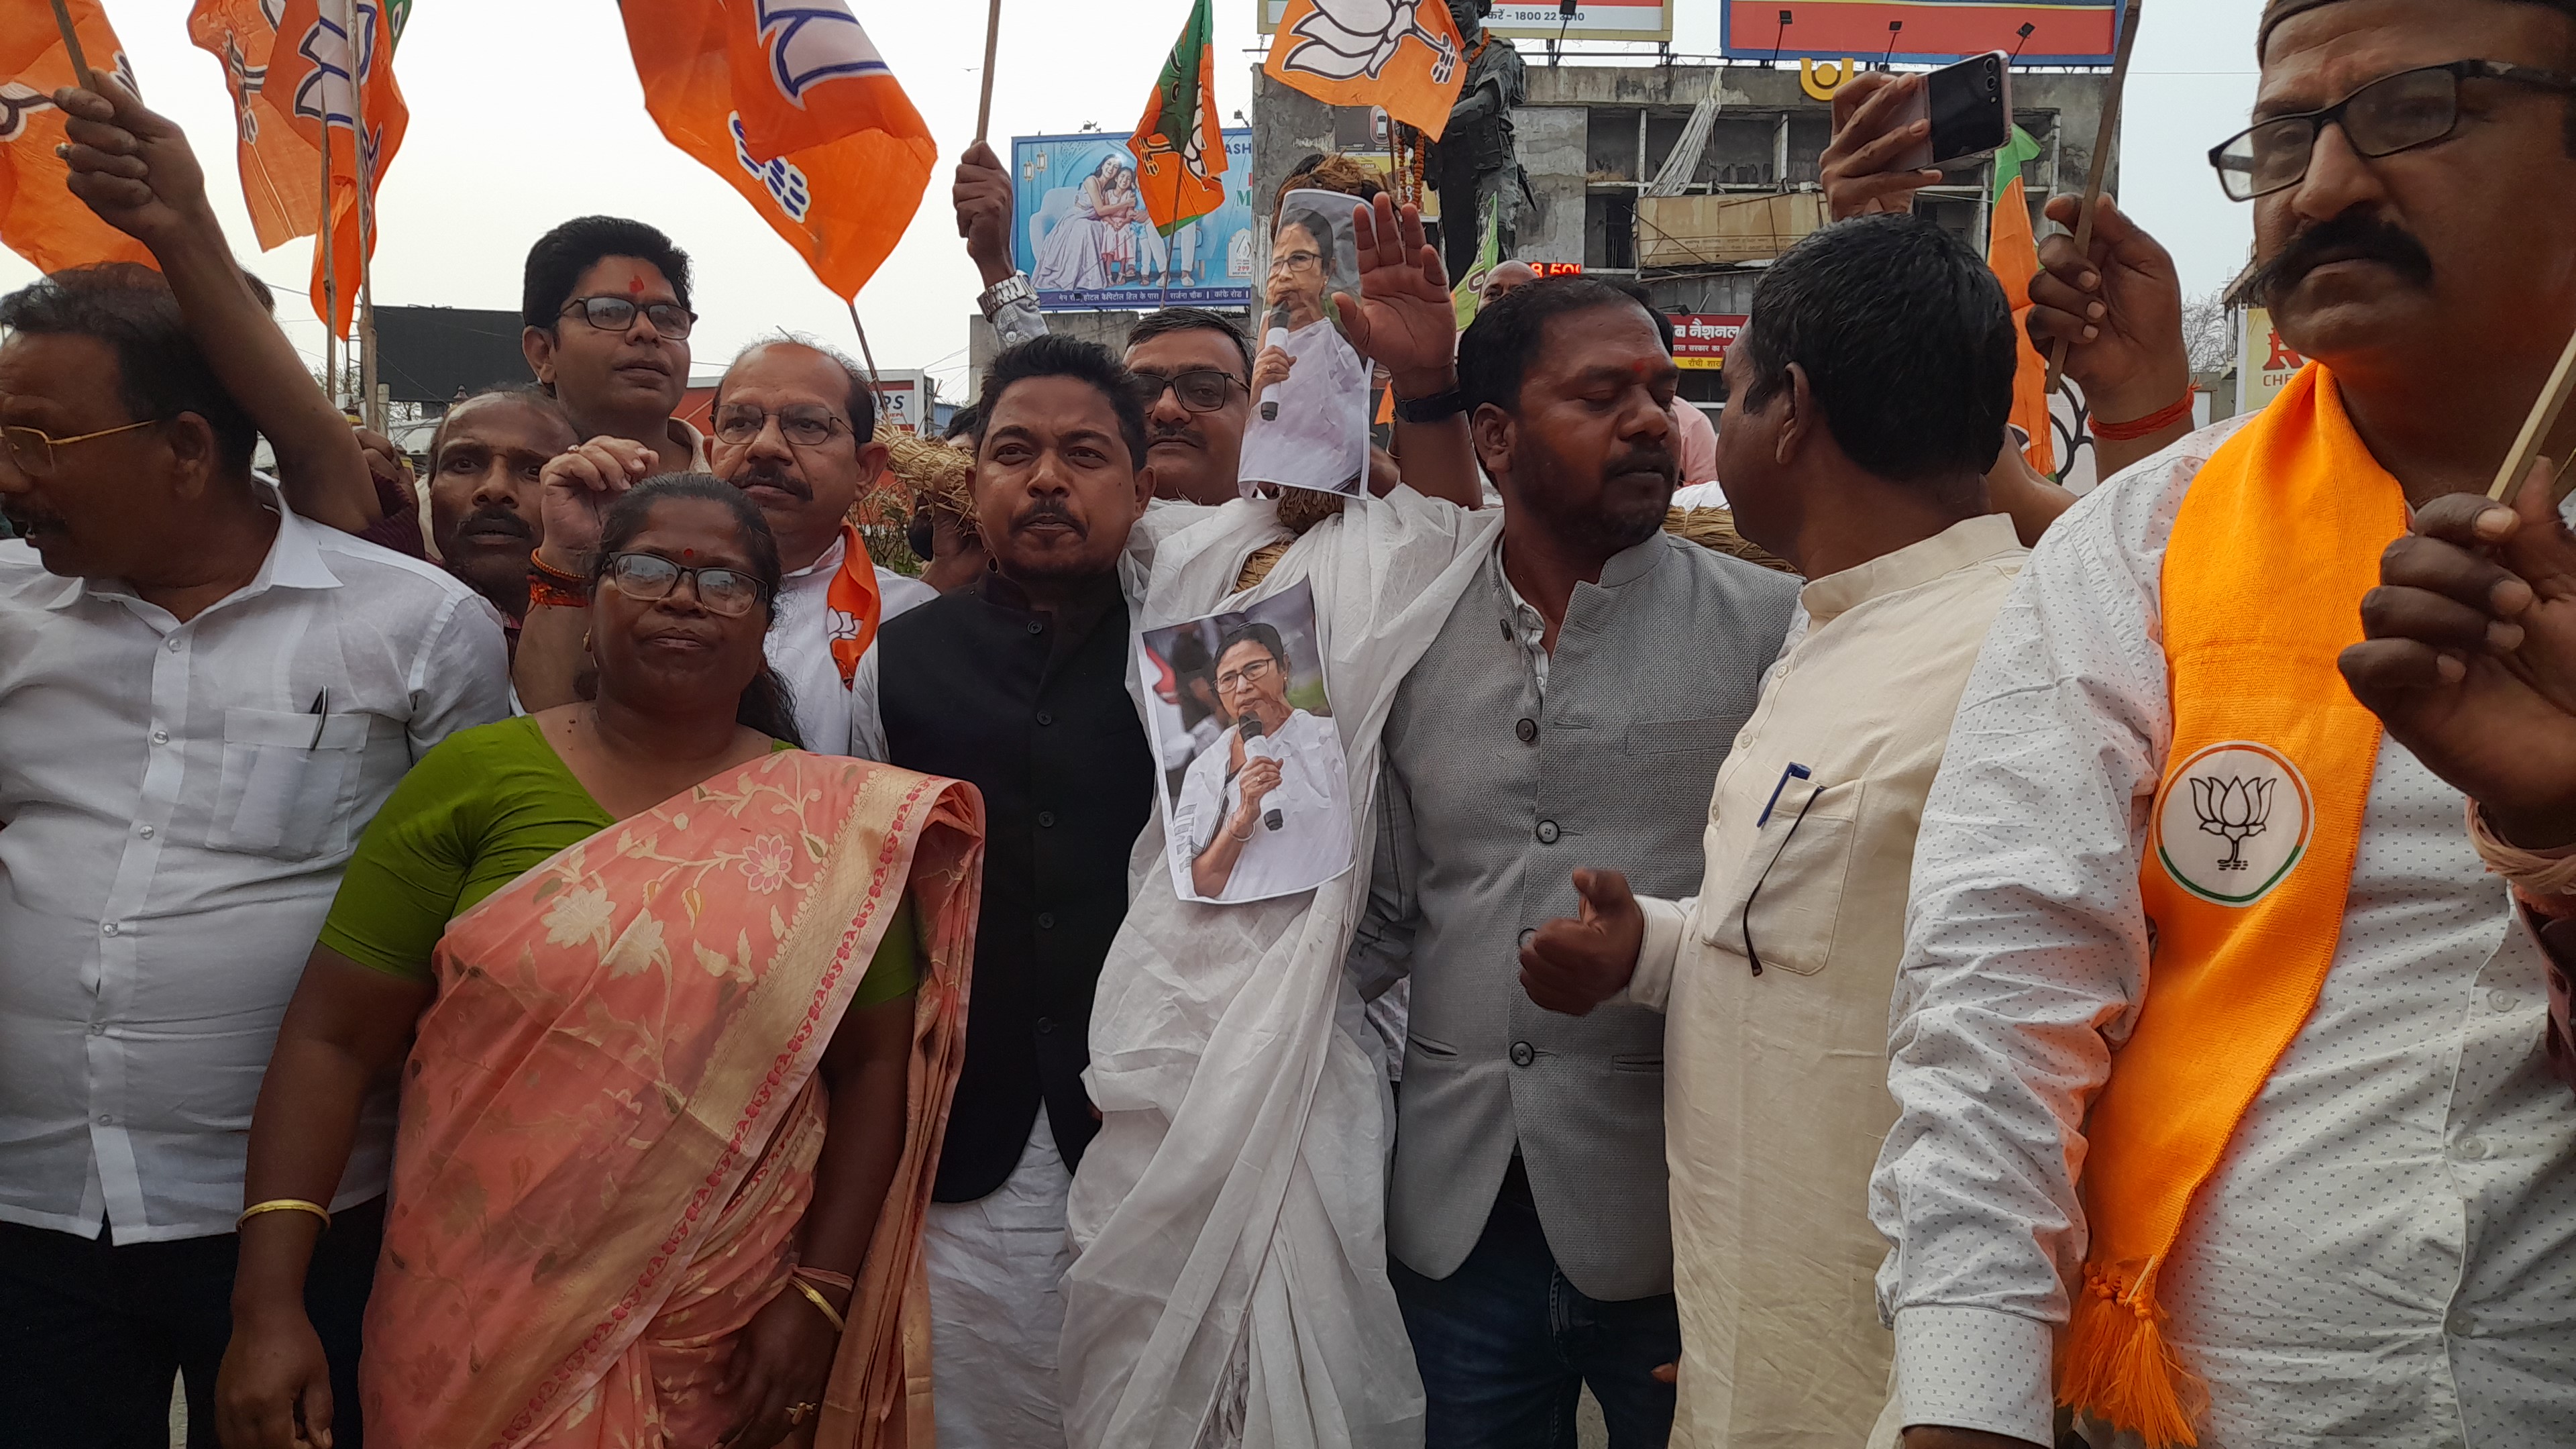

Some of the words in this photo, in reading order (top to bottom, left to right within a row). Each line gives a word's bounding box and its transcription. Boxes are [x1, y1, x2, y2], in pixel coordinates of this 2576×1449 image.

[1515, 11, 1541, 21] 1800
[1544, 12, 1556, 21] 22
[1083, 293, 1099, 301] होटल
[1126, 292, 1137, 300] हिल
[1140, 291, 1146, 300] के
[1689, 317, 1740, 340] नैशनल
